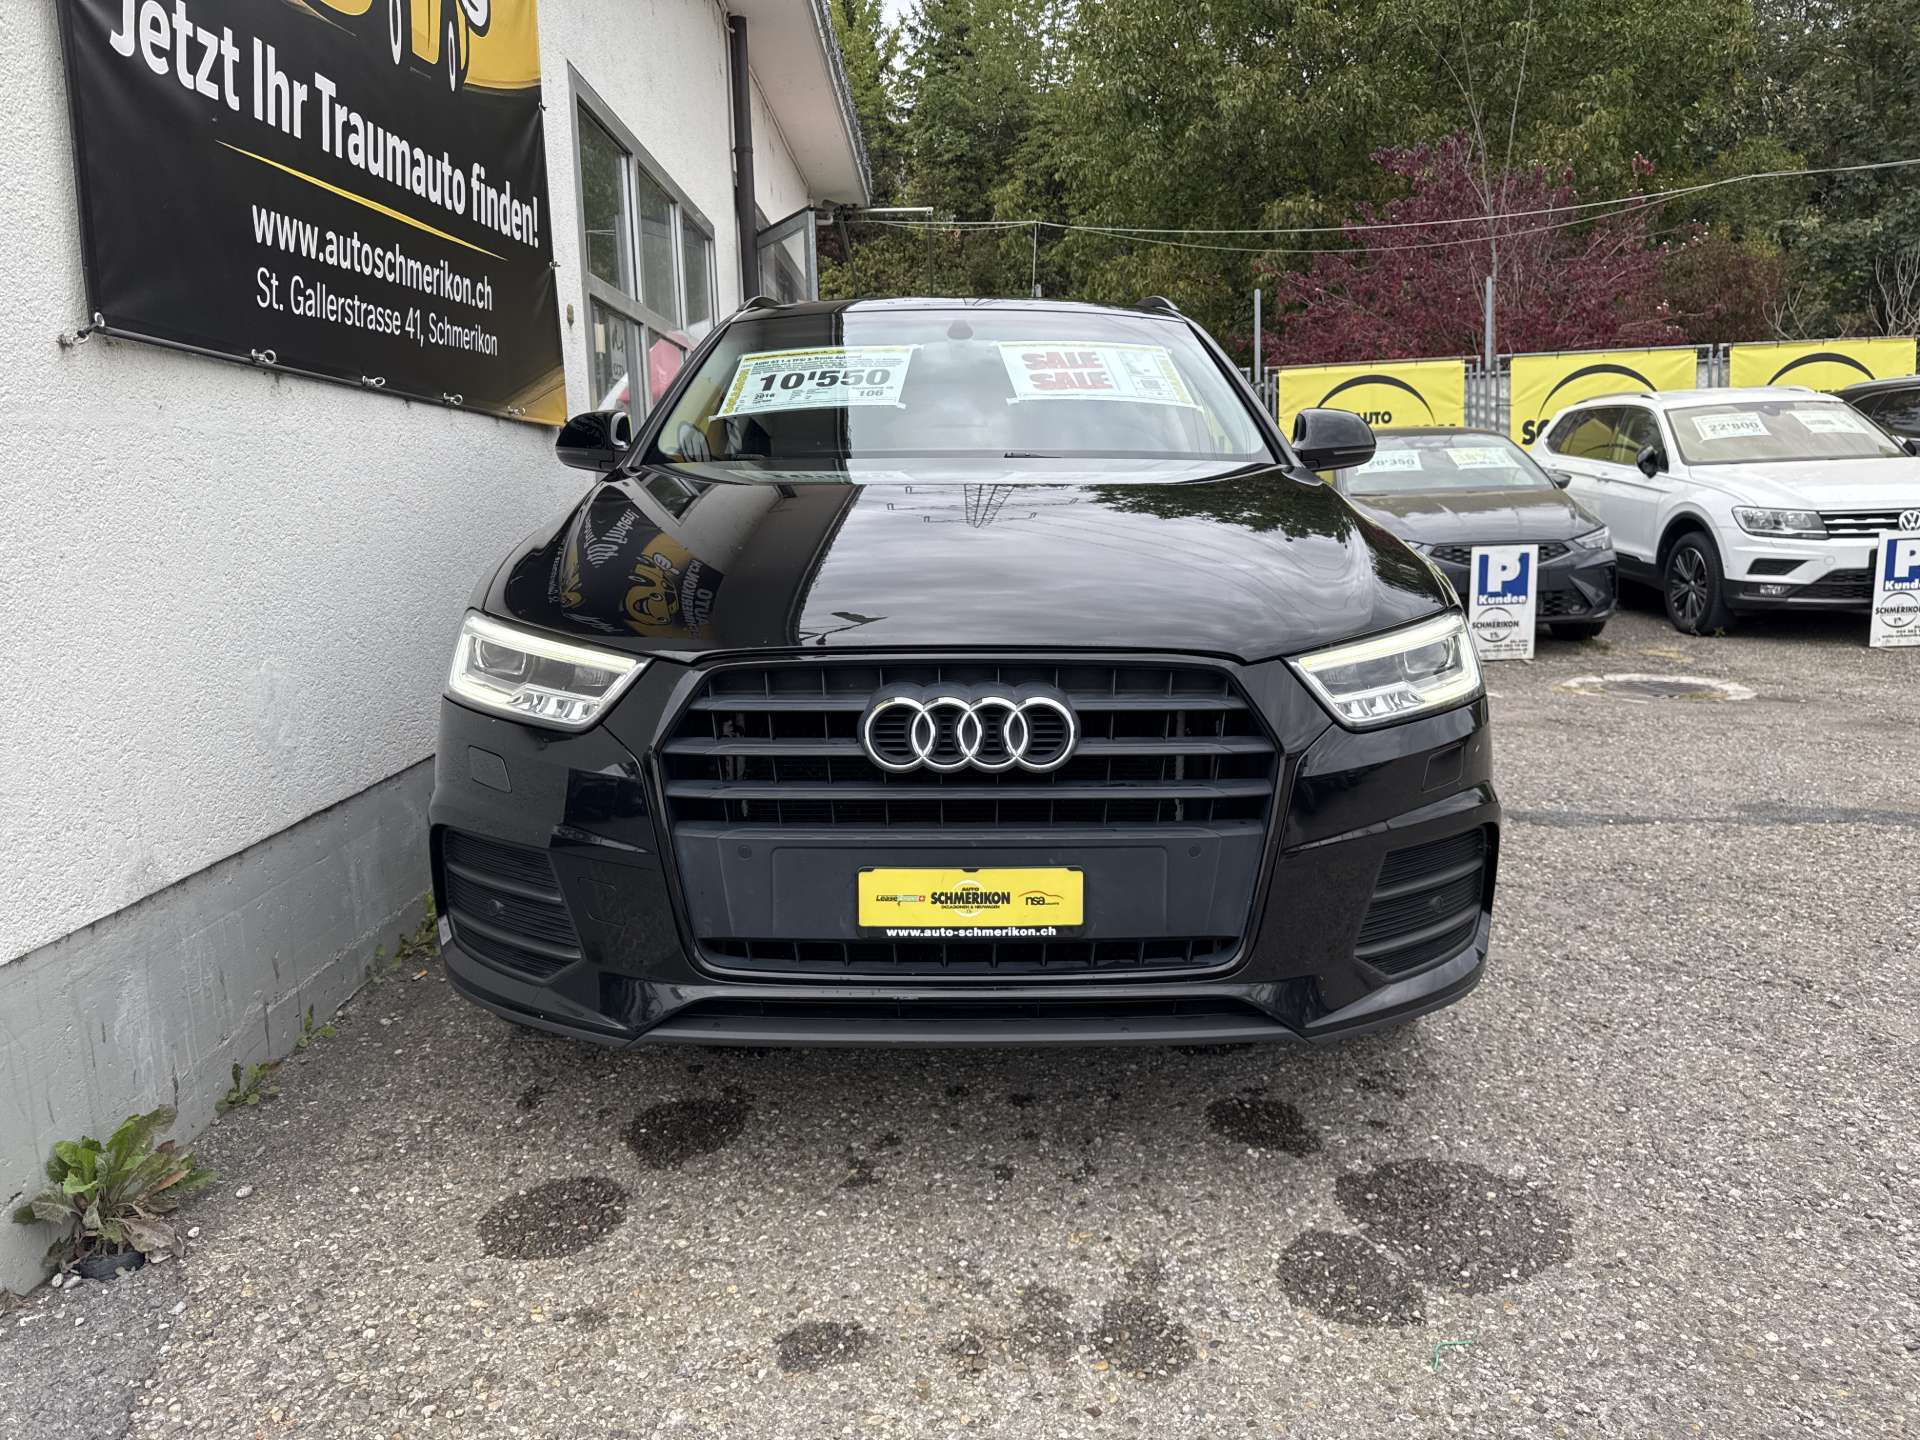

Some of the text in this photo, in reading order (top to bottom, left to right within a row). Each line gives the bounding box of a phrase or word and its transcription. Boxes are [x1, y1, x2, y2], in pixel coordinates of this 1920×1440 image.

[109, 0, 539, 248] Jetzt Ihr Traumauto finden!
[252, 204, 493, 311] www.autoschmerikon.ch
[256, 267, 498, 356] St. Gallerstrasse 41, Schmerikon
[1021, 351, 1104, 370] SALE
[759, 368, 891, 392] 10'550
[1029, 371, 1114, 390] SALE
[1356, 411, 1392, 424] UTO
[1884, 579, 1920, 591] Kund
[1478, 593, 1528, 605] Kunden
[1472, 620, 1519, 630] SCHMERIKON
[931, 892, 1010, 904] SCHMERIKON
[1025, 896, 1045, 905] nsa
[886, 927, 1056, 936] www.auto-schmerikon.ch
